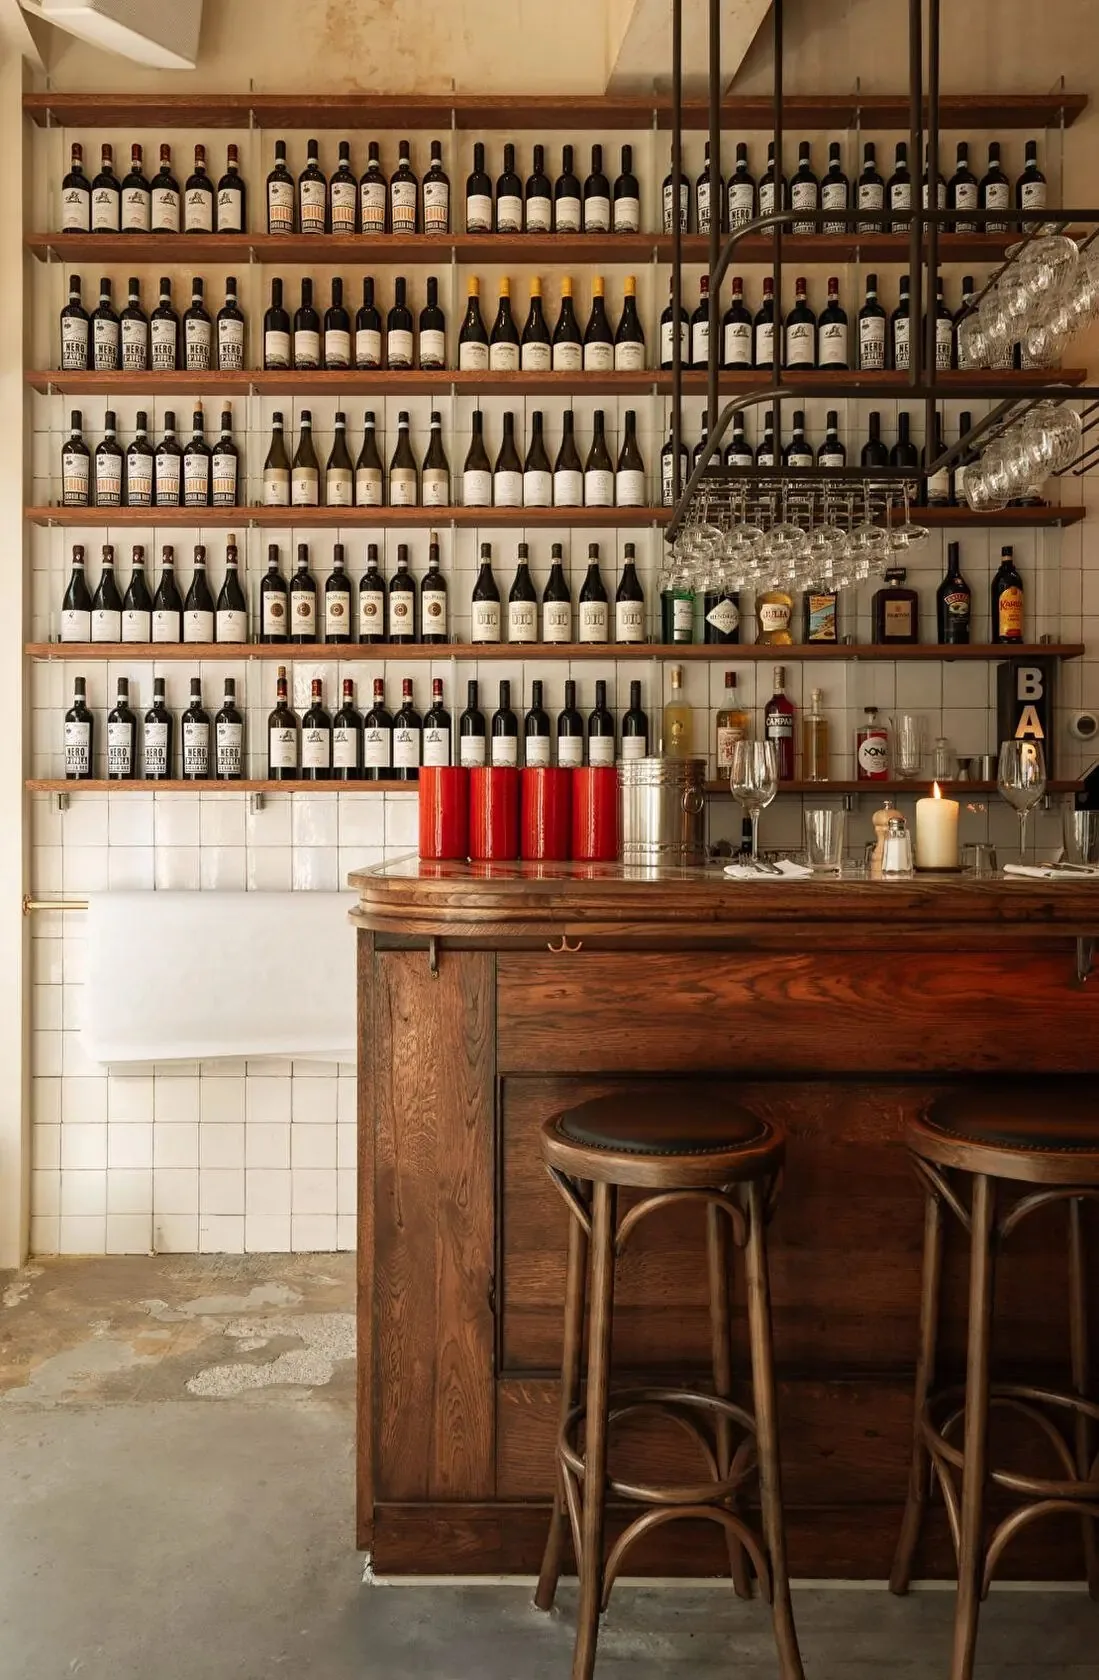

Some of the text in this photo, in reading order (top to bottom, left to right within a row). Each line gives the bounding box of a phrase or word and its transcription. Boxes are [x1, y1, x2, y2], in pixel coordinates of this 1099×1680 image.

[66, 342, 85, 353] NERO
[98, 344, 117, 356] NERO
[126, 344, 145, 356] NERO
[155, 344, 173, 354] NERO
[190, 344, 209, 356] NERO
[222, 344, 241, 355] NERO
[863, 342, 883, 352] NERO
[1014, 667, 1044, 781] BAR
[67, 747, 86, 757] NERO
[109, 747, 128, 757] NERO
[146, 747, 163, 757] NERO
[187, 747, 207, 757] NERO
[220, 748, 239, 757] NERO
